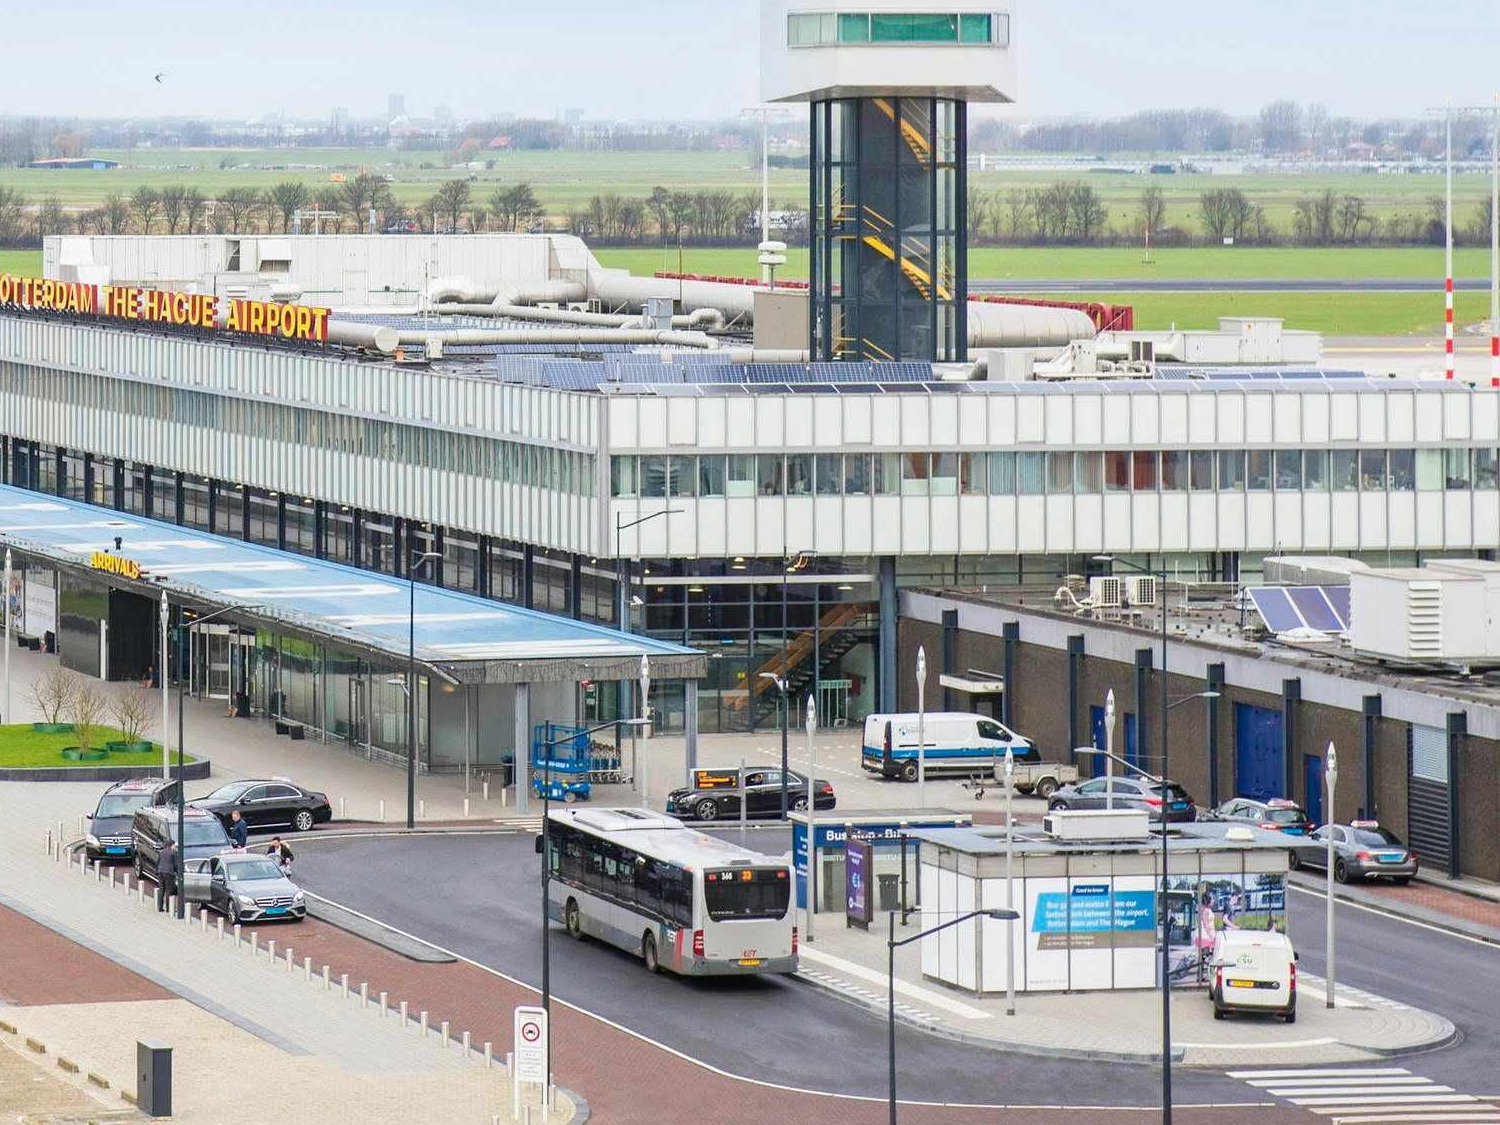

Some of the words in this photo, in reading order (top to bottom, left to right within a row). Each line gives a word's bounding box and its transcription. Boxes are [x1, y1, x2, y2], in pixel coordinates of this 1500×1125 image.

[102, 285, 138, 319] THE
[144, 289, 215, 328] HAGUE
[227, 298, 328, 341] AIRPORT
[91, 551, 140, 579] ARRIVALS
[826, 830, 847, 841] Bus
